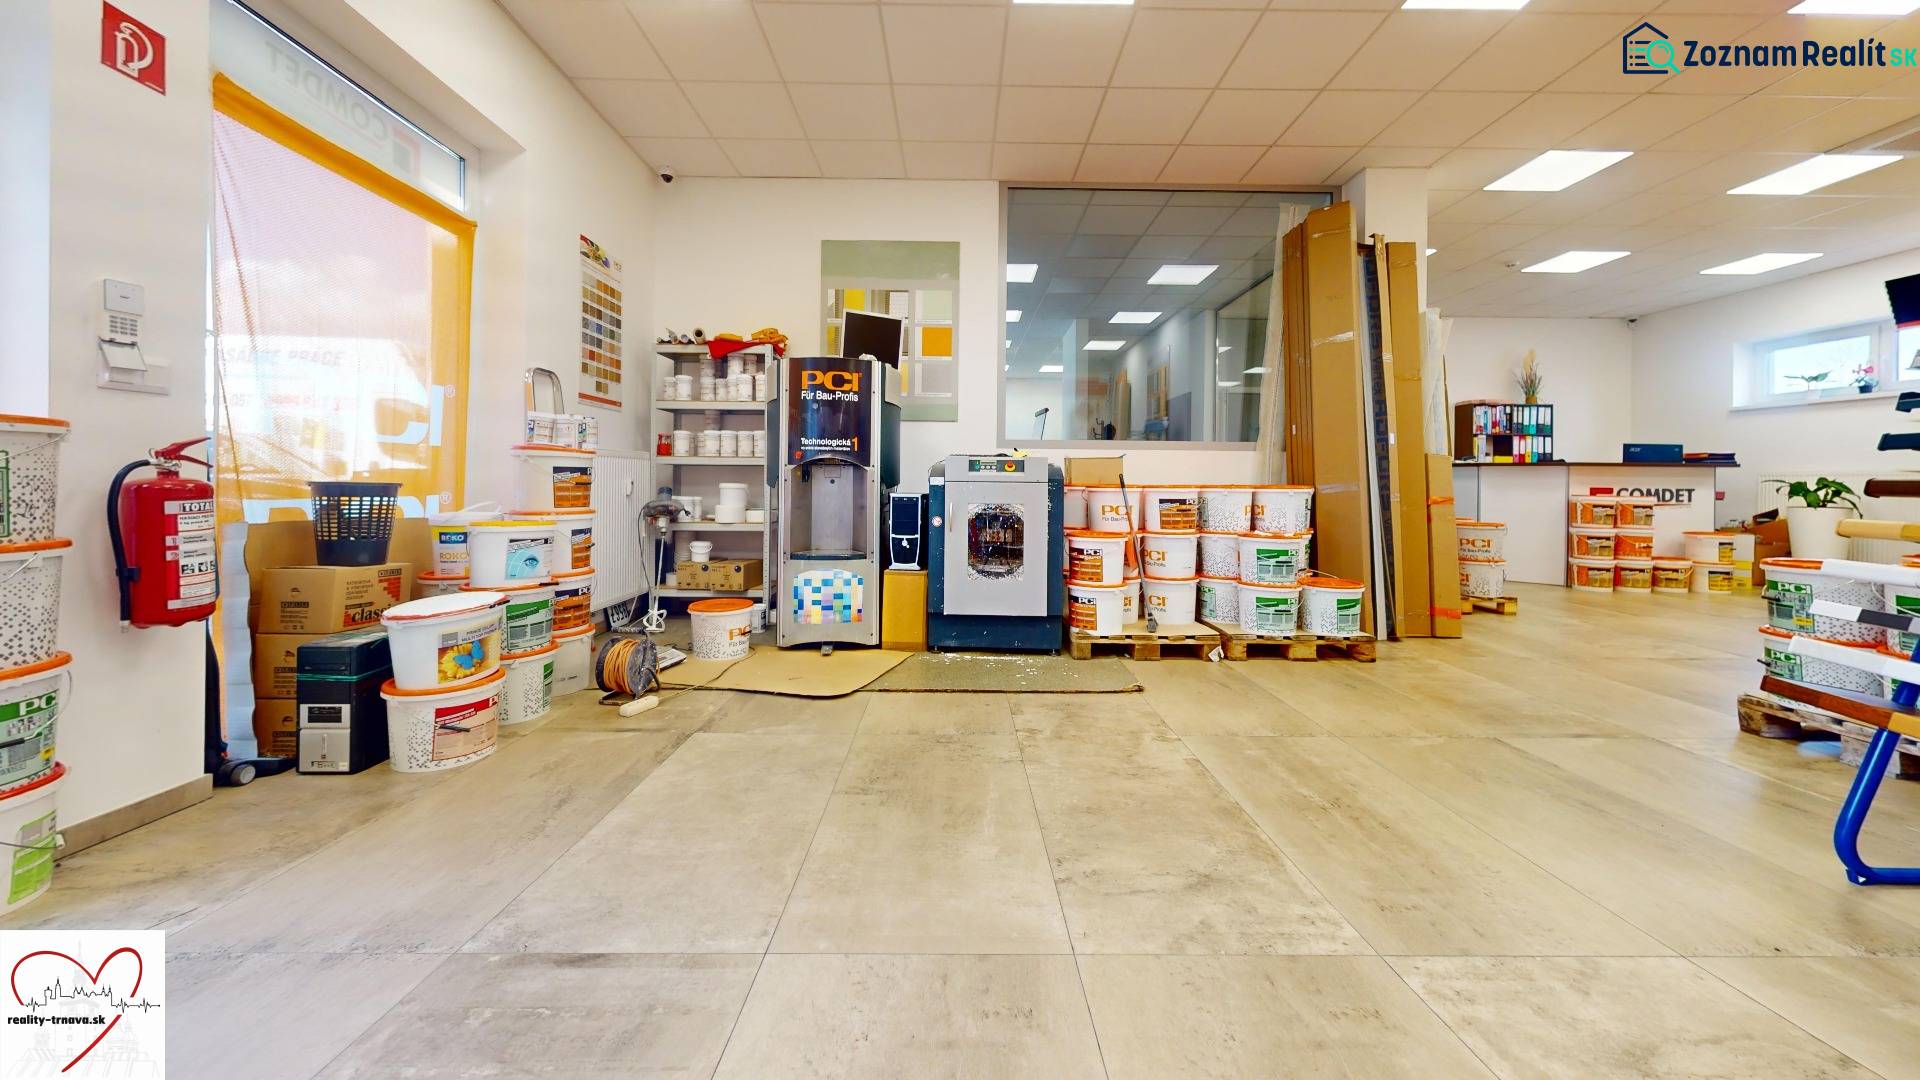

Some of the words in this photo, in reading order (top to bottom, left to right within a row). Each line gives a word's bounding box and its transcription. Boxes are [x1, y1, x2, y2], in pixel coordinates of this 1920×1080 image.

[801, 370, 859, 392] PCI
[801, 391, 814, 400] Für
[816, 391, 858, 401] Bau-Profis
[800, 437, 851, 447] Technologická
[1777, 582, 1811, 594] PCI
[1770, 650, 1801, 663] PCI
